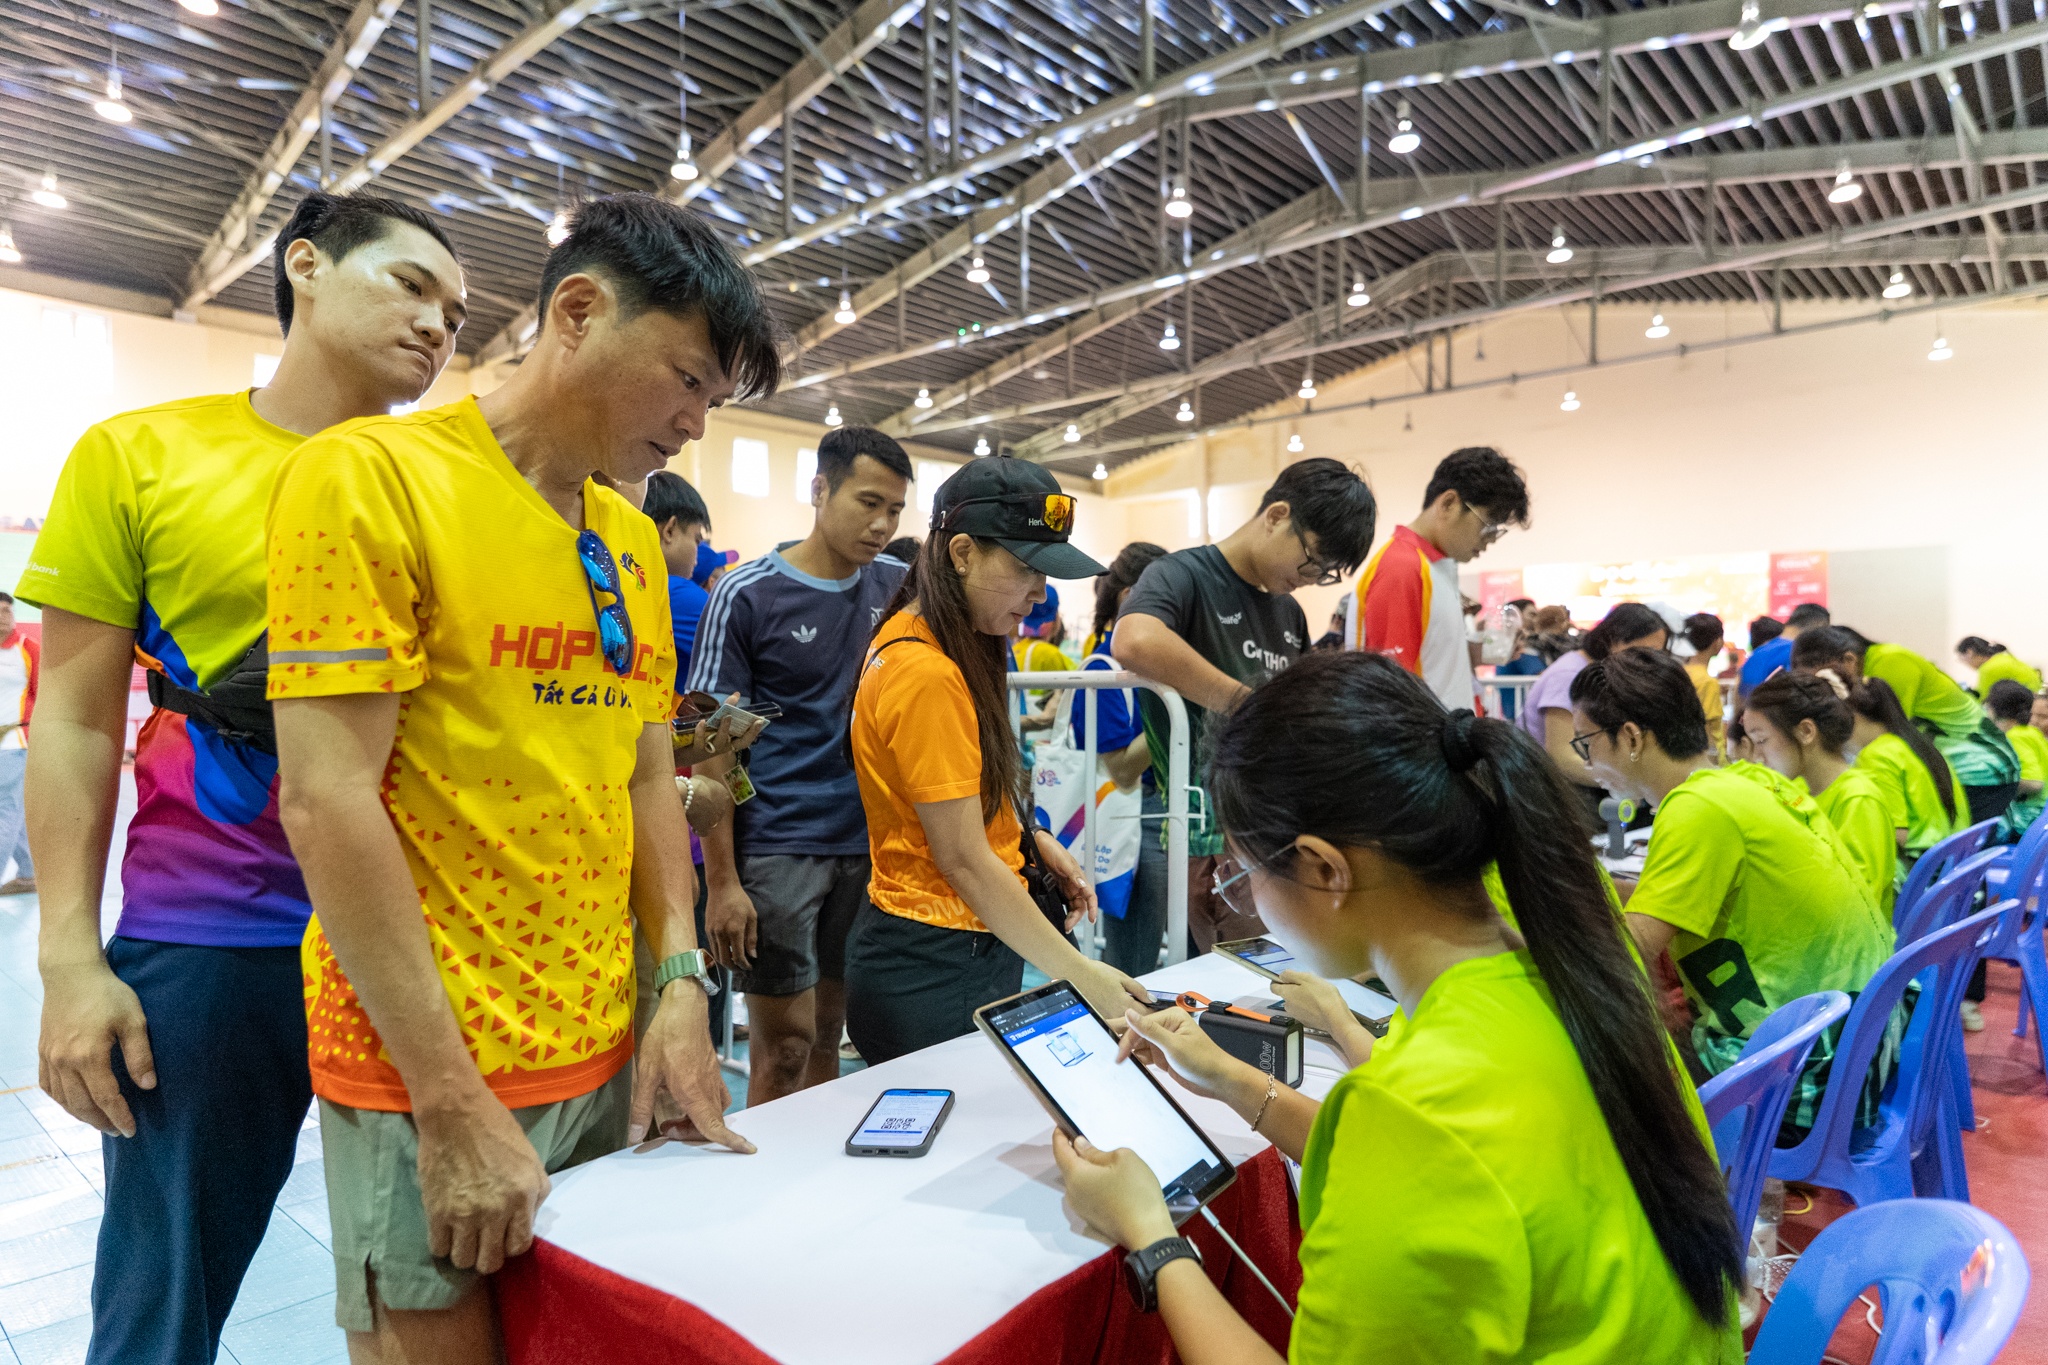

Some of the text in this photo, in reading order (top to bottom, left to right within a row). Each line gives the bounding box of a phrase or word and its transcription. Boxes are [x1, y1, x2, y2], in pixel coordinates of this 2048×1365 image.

[31, 562, 60, 577] bank
[490, 621, 596, 675] HỢP
[532, 679, 564, 705] Tất
[571, 684, 597, 706] Cả
